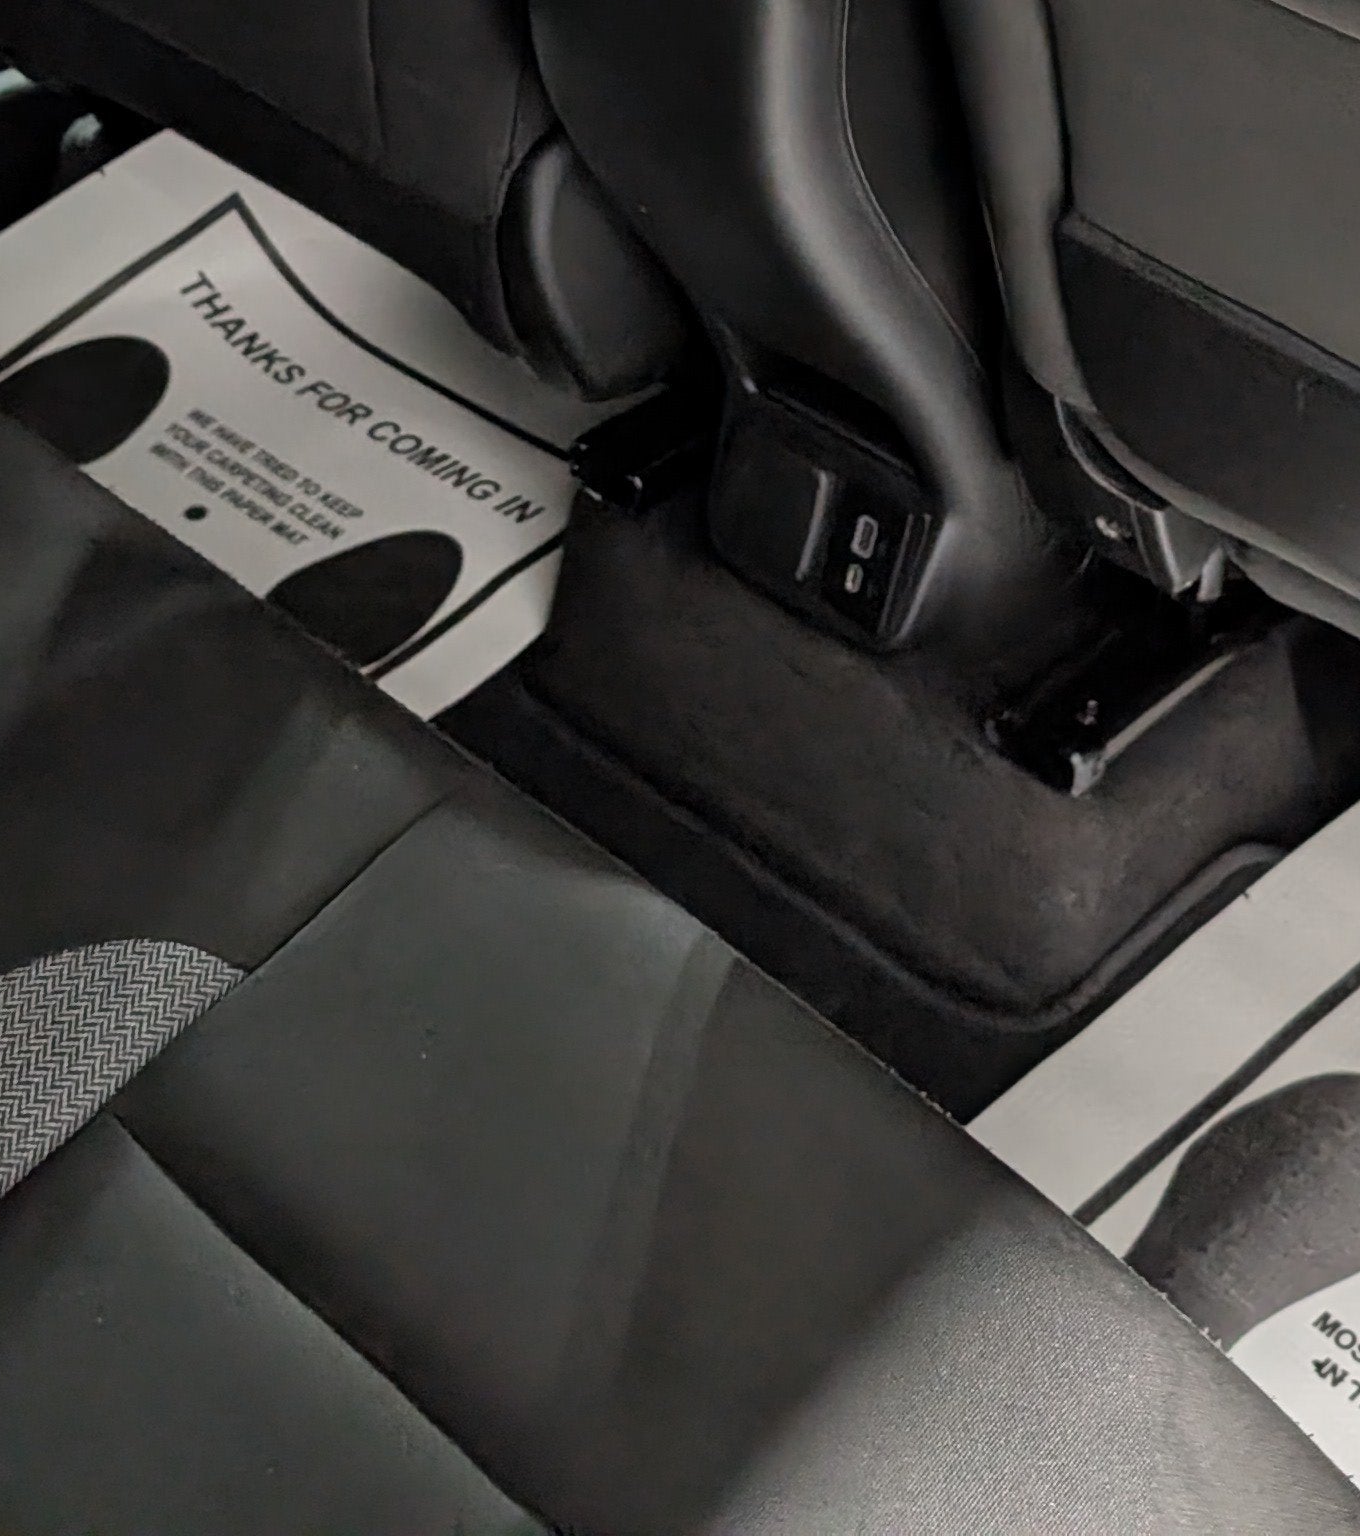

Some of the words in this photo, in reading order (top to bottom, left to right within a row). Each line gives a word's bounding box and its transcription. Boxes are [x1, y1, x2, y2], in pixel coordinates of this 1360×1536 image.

[179, 270, 307, 386] THANKS
[294, 379, 375, 427] FOR
[365, 420, 503, 502] COMING
[491, 494, 547, 525] IN
[295, 477, 322, 497] TO
[316, 491, 365, 519] KEEP
[286, 502, 346, 541] CLEAN
[1316, 1357, 1349, 1388] IN
